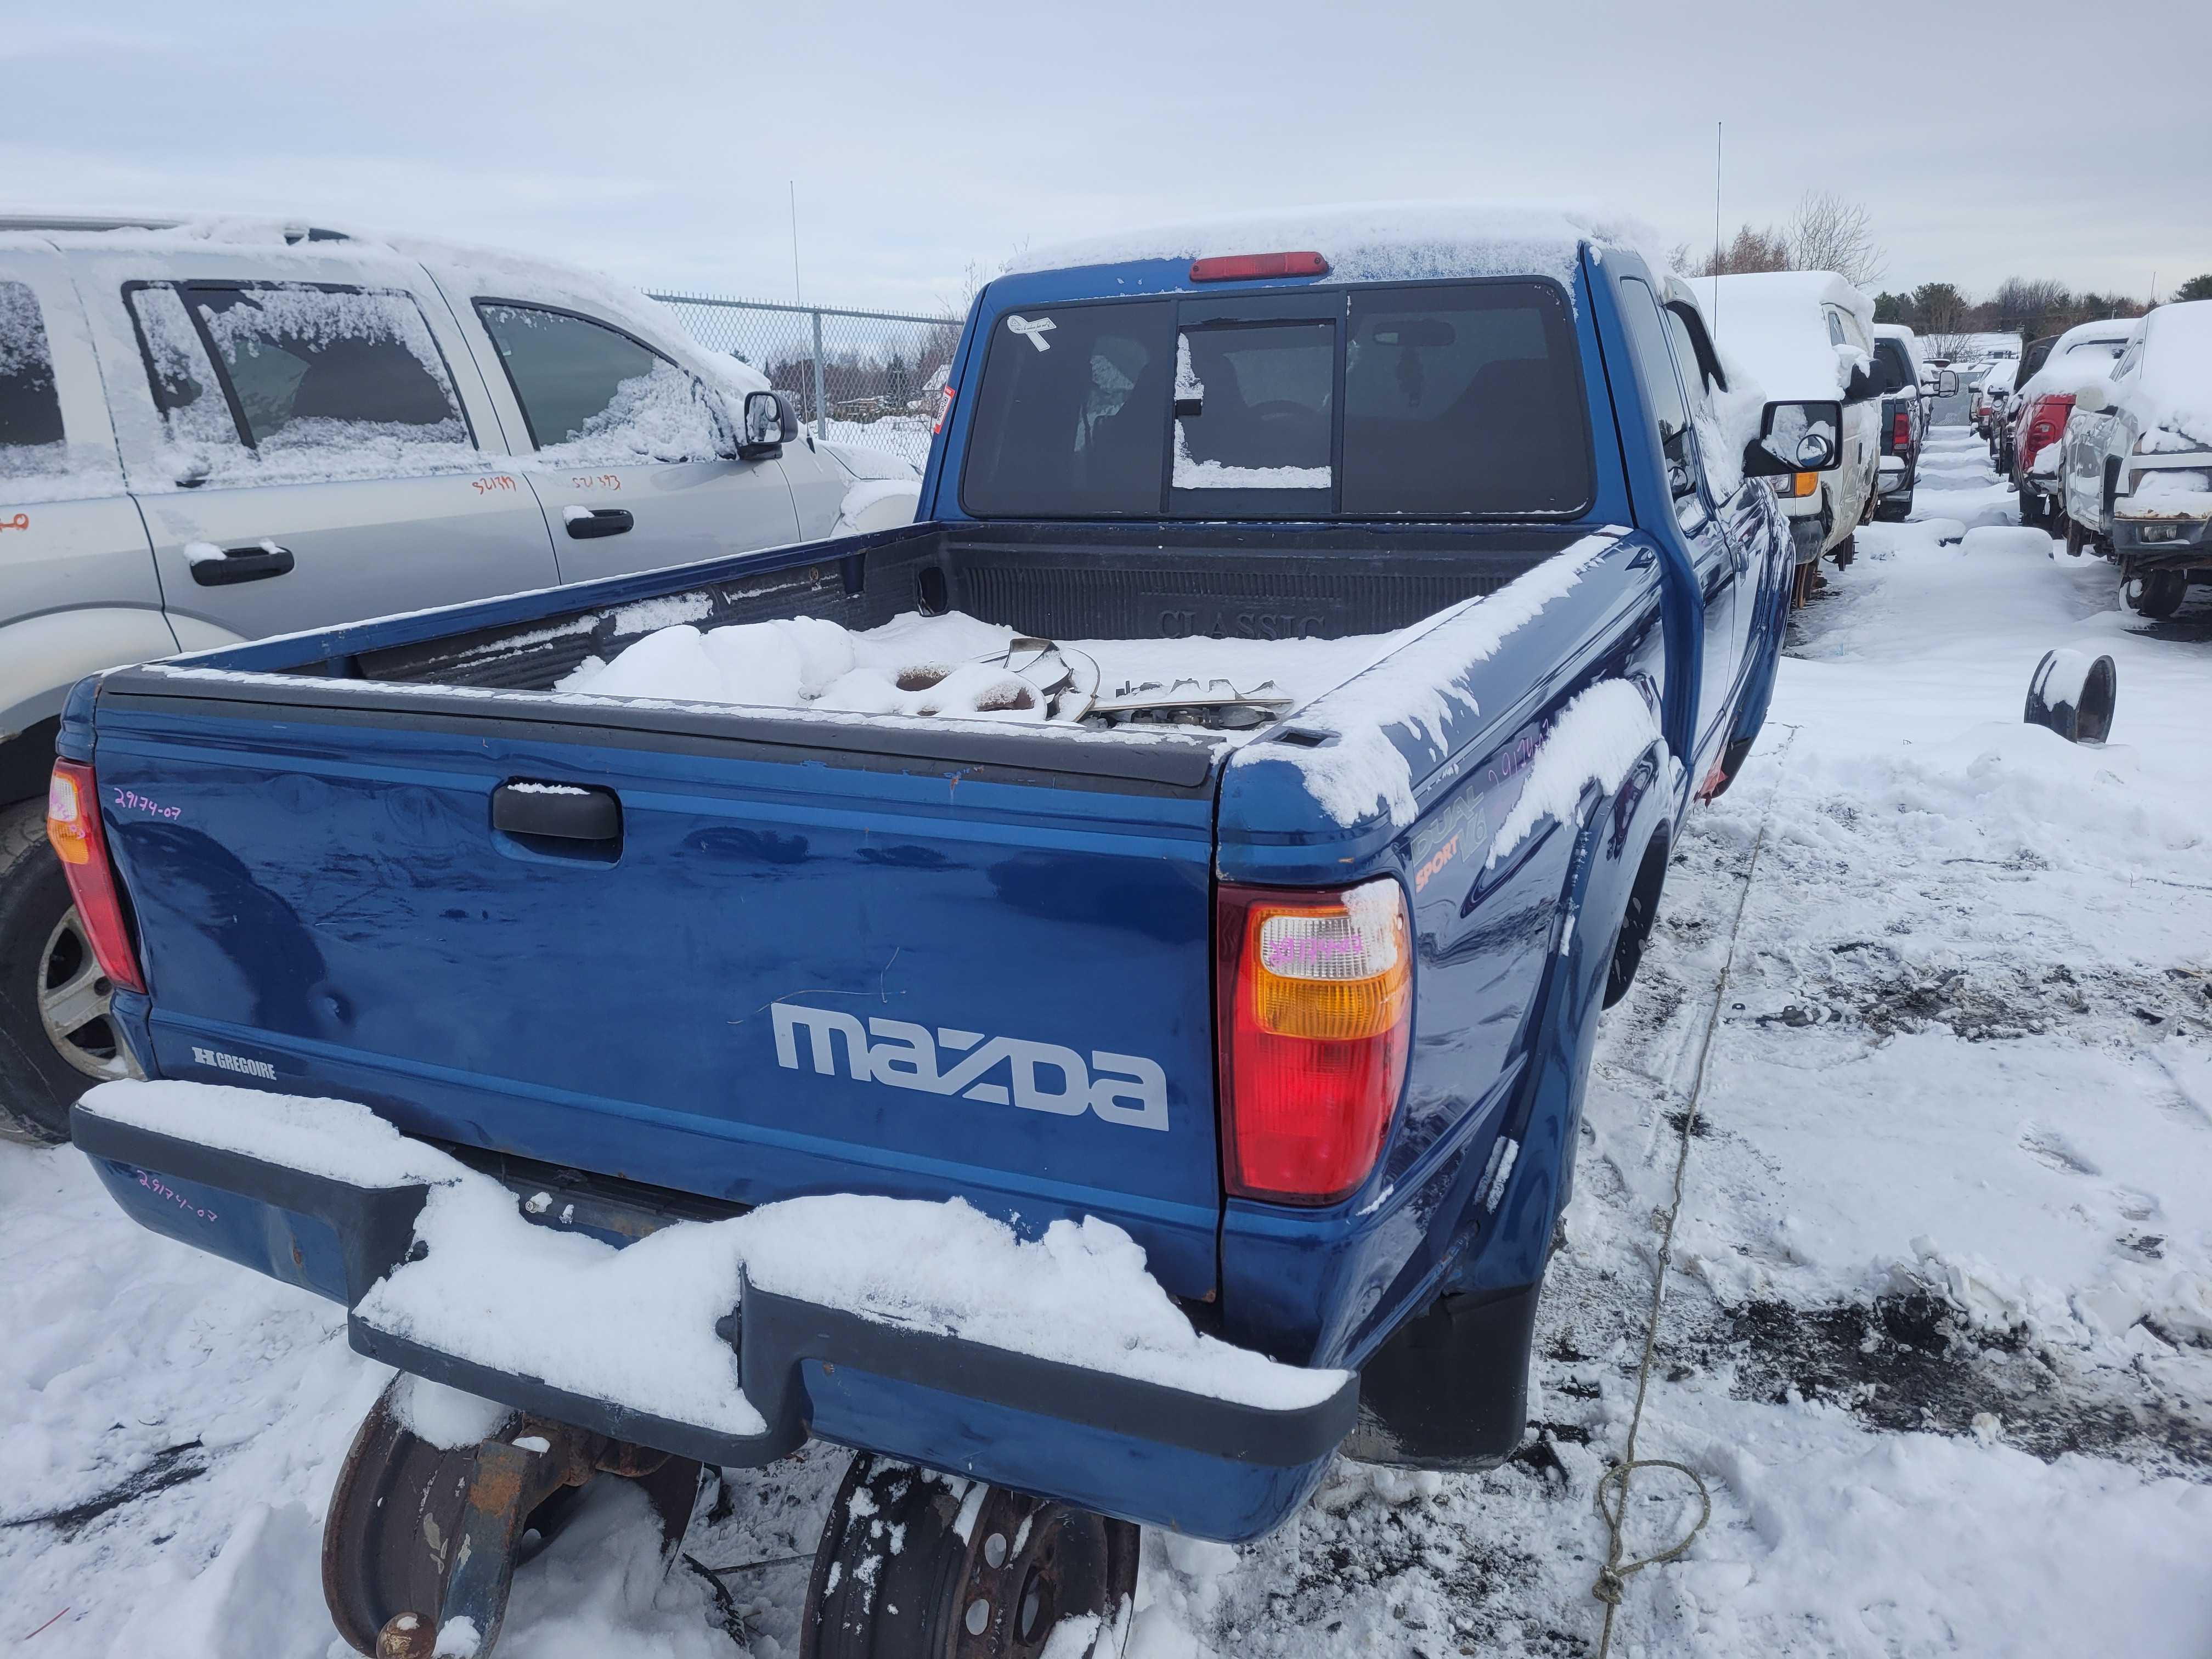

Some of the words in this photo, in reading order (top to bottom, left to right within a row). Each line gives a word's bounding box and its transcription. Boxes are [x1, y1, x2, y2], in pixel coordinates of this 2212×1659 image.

[1158, 610, 1325, 641] CLASSIC
[114, 788, 182, 820] 29174-07
[1410, 786, 1484, 867] DUAL
[1415, 834, 1458, 894] SPORT
